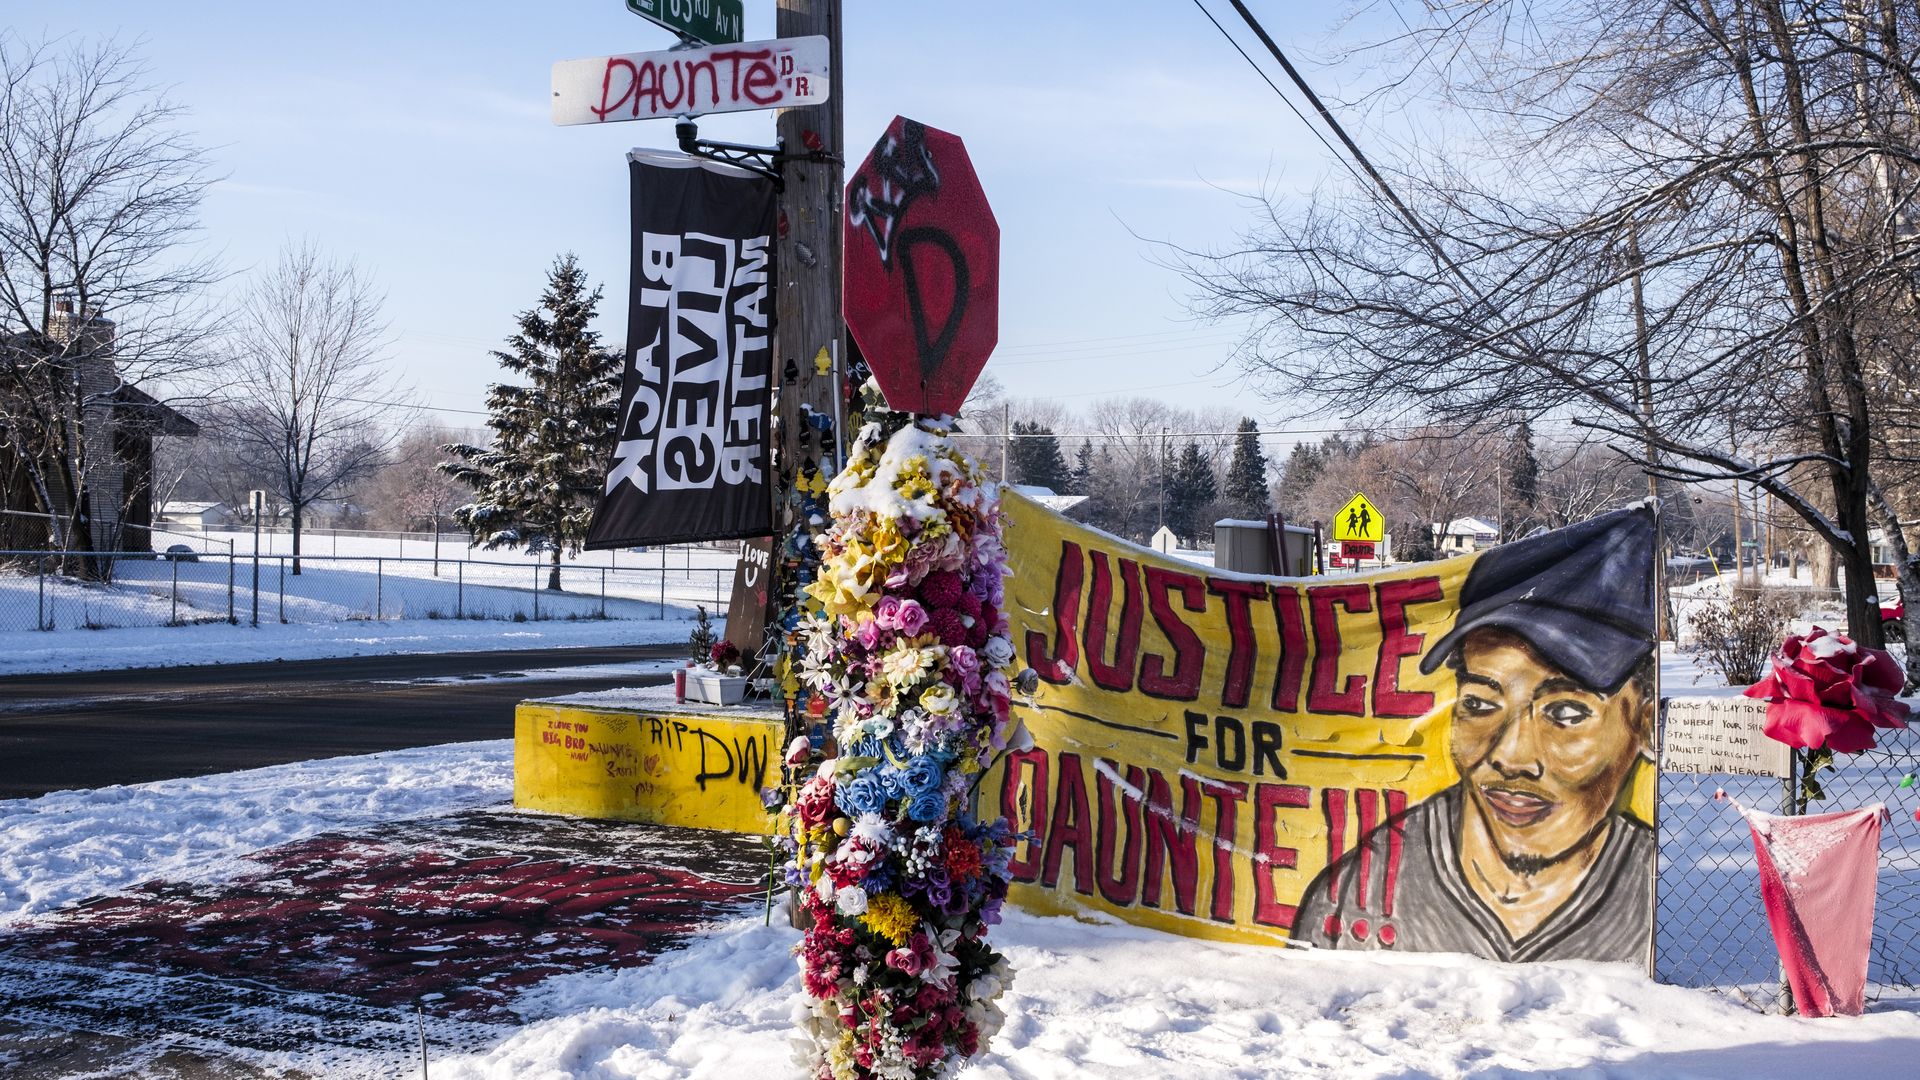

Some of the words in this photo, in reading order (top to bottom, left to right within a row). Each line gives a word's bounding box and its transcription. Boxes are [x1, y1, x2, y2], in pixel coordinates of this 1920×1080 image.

[733, 14, 739, 42] N
[745, 544, 770, 570] LOVE
[744, 567, 759, 588] U
[1025, 541, 1444, 718] JUSTICE
[1744, 705, 1754, 713] TO
[574, 722, 589, 734] YOU
[1722, 719, 1742, 730] YOUR
[1184, 711, 1287, 779] FOR
[1669, 743, 1704, 754] DAUNTE
[1710, 749, 1760, 761] WRIGHT
[1710, 765, 1722, 773] IN
